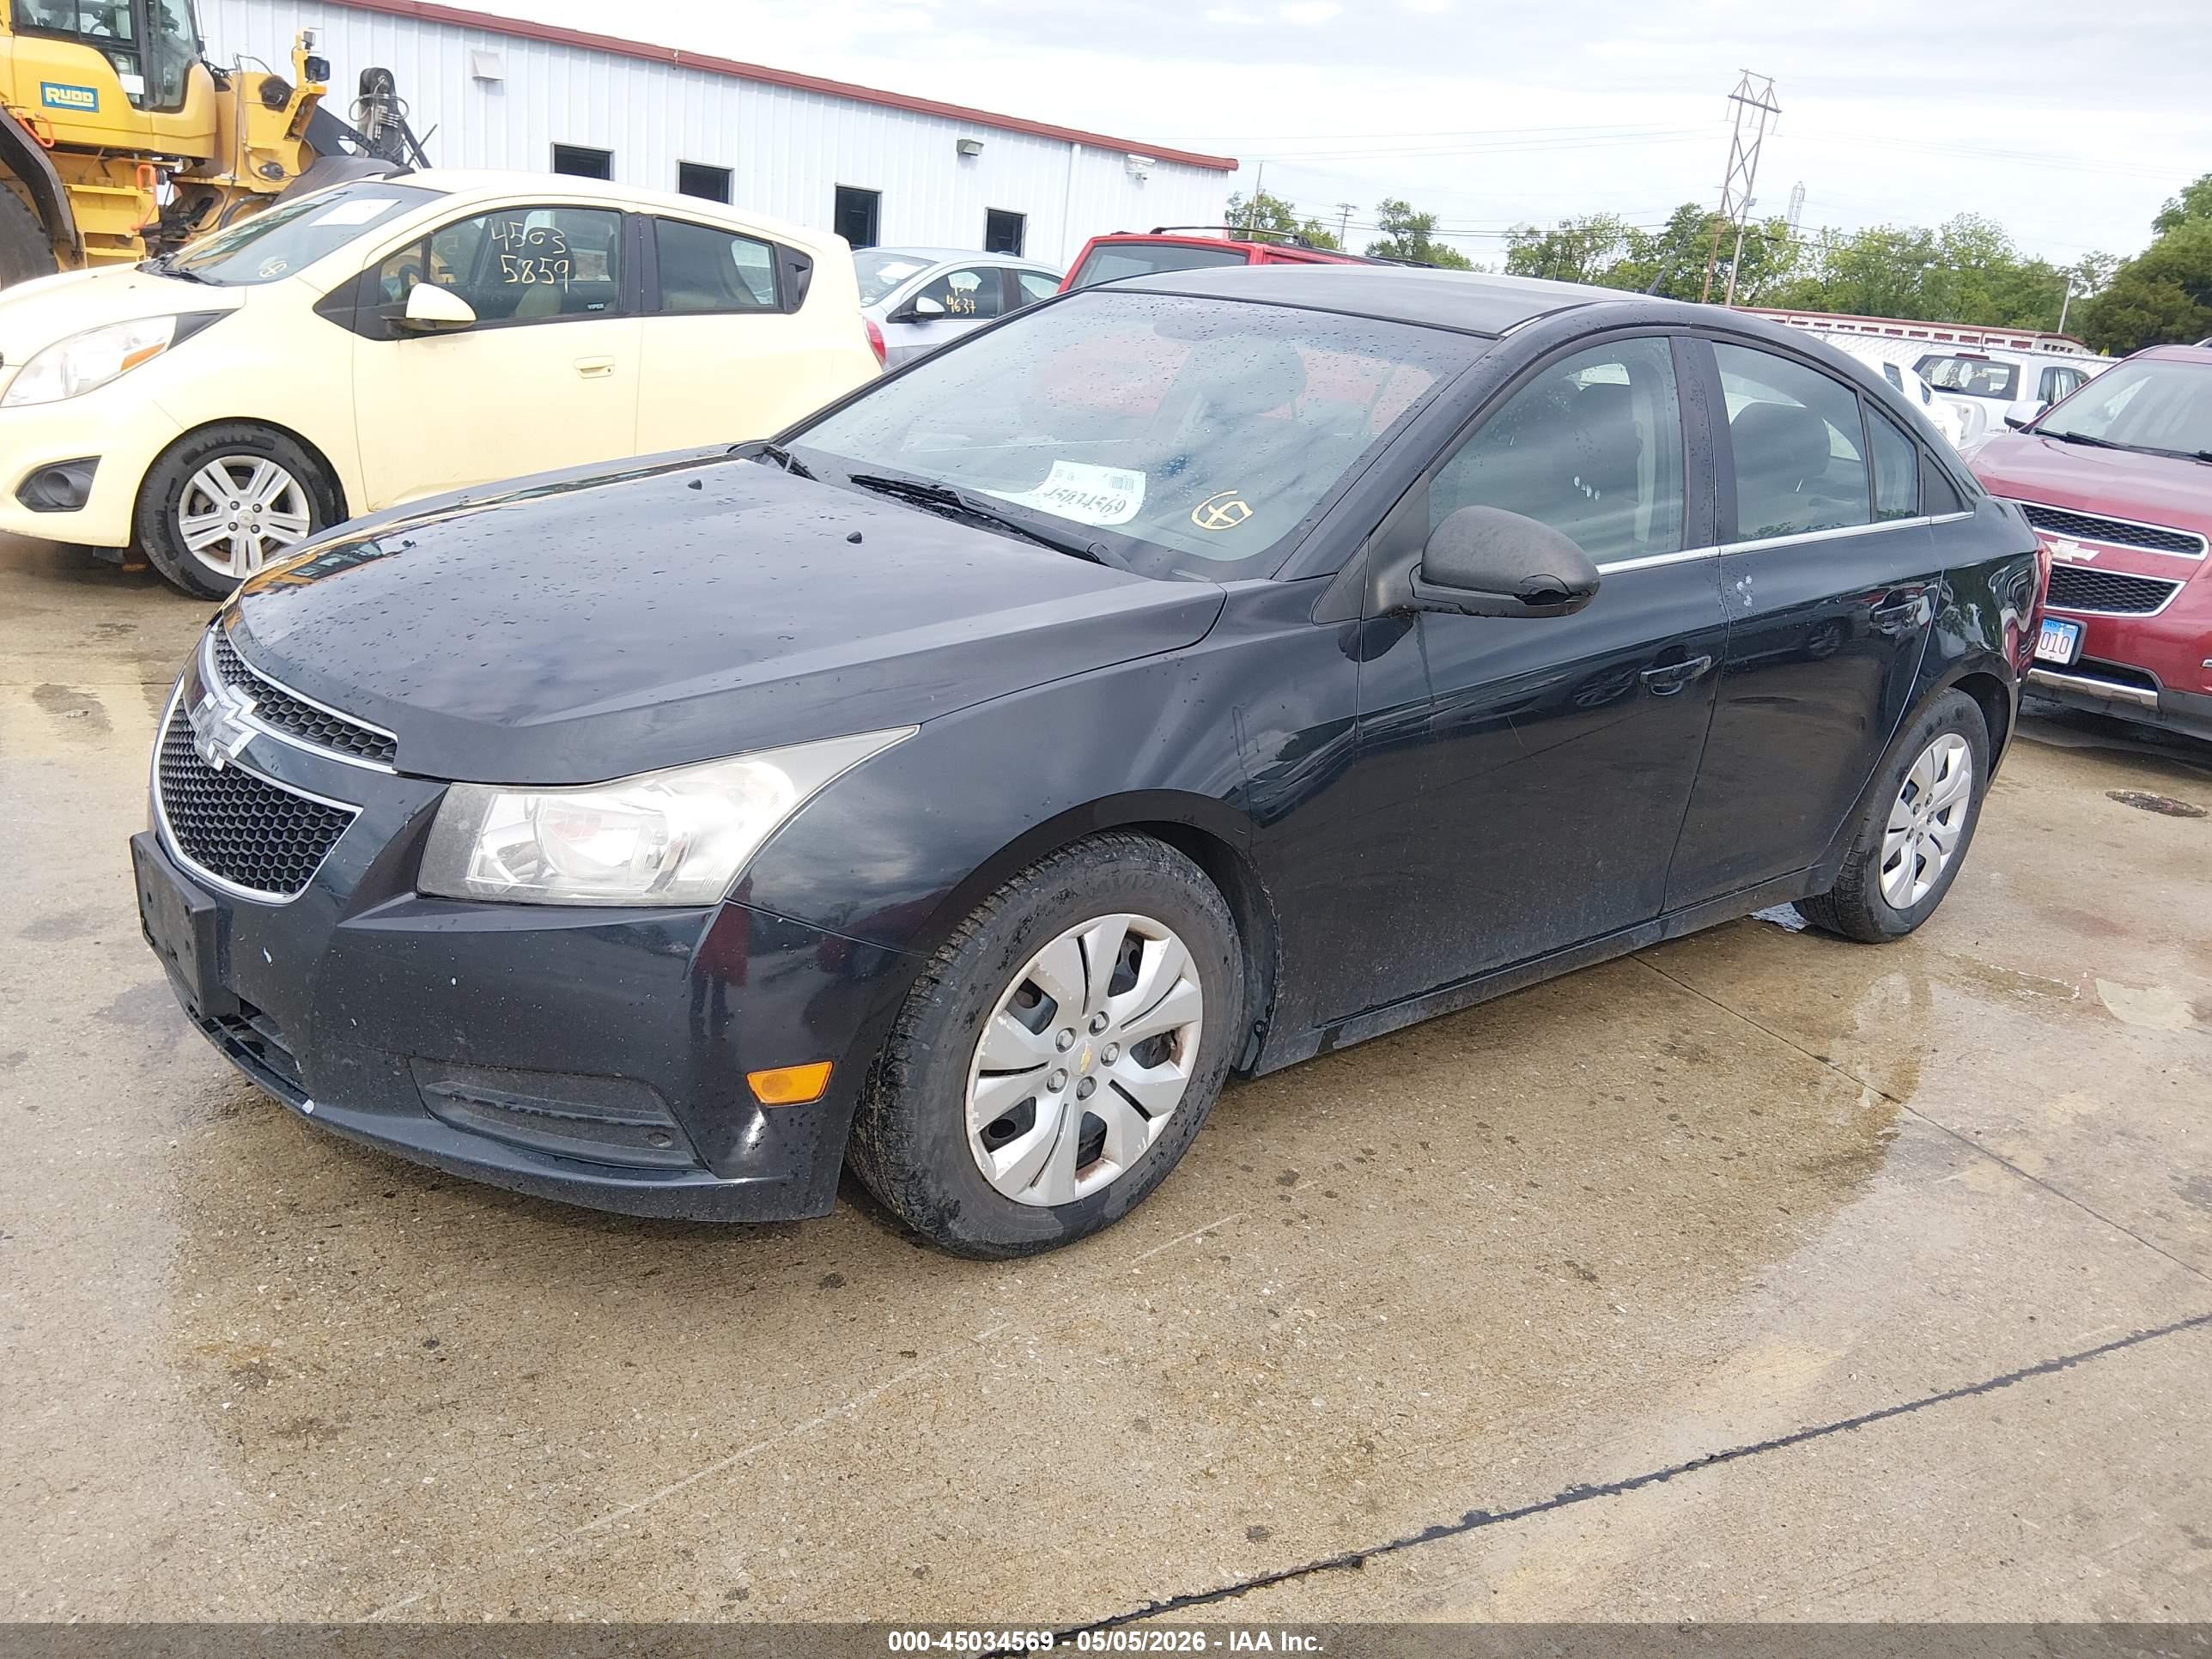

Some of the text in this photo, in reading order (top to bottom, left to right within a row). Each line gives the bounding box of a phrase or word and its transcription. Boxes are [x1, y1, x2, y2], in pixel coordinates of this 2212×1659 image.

[45, 87, 94, 107] RUDD
[489, 218, 567, 252] 4503
[501, 254, 569, 294] 5859
[946, 295, 975, 314] 4637
